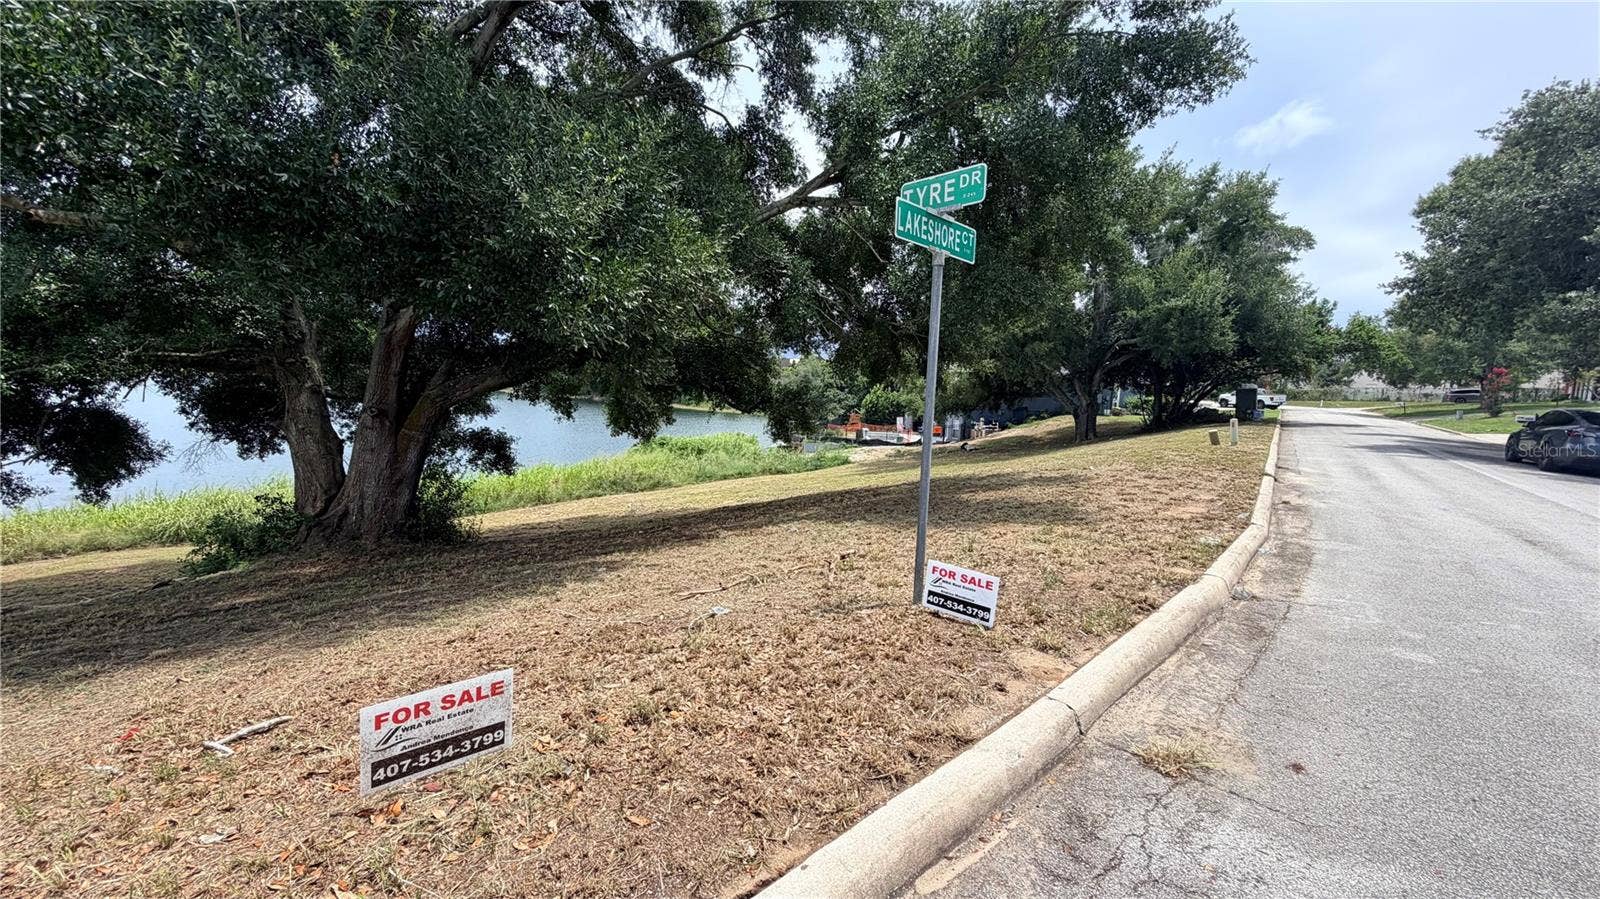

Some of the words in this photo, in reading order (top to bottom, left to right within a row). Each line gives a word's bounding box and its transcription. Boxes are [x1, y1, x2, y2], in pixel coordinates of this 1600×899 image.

[904, 179, 956, 209] TYRE
[960, 171, 982, 188] DR
[898, 207, 961, 252] LAKESHORE
[962, 232, 974, 246] CT
[931, 566, 956, 580] FOR
[960, 574, 994, 591] SALE
[928, 595, 990, 619] 407-534-3799
[374, 701, 432, 731] FOR
[440, 680, 505, 711] SALE
[401, 722, 423, 733] WRA
[425, 715, 445, 726] Real
[447, 707, 474, 719] Estate
[373, 730, 504, 781] 407-534-3799
[400, 738, 432, 751] Andrea
